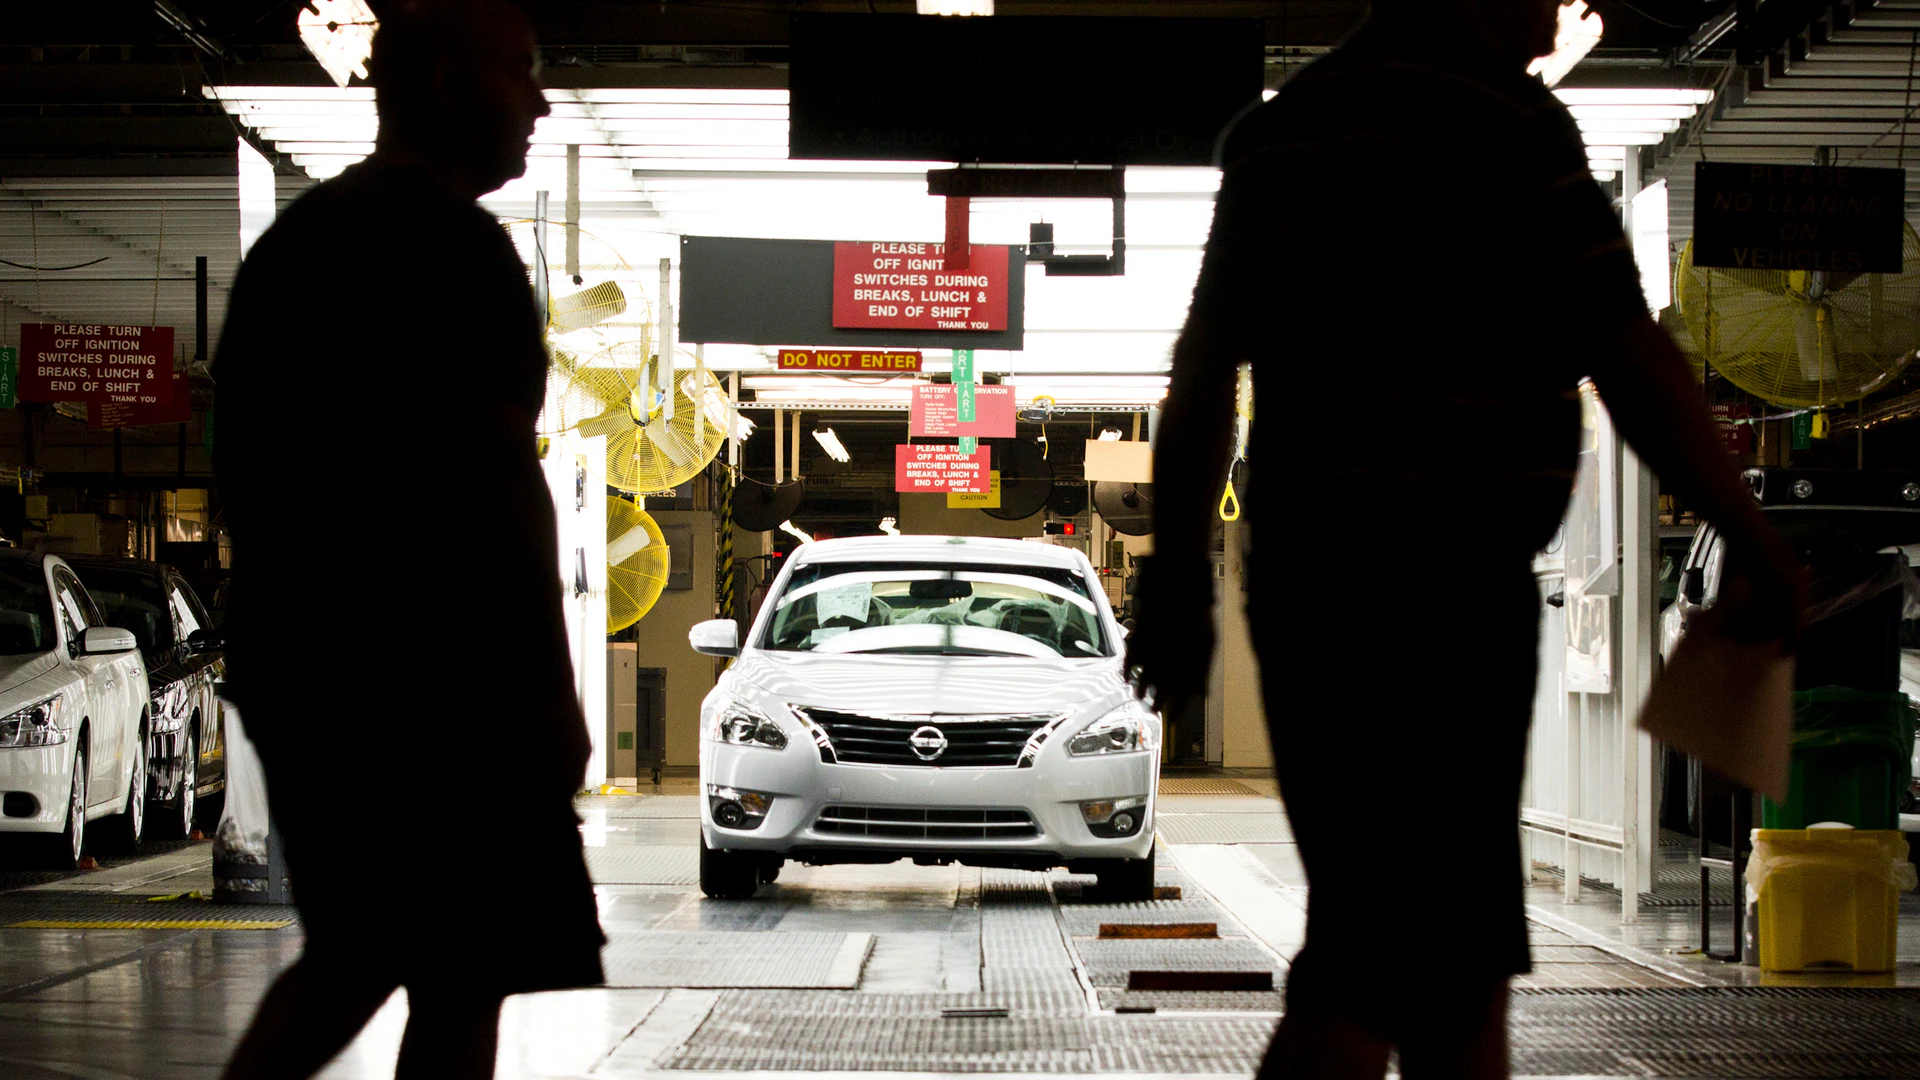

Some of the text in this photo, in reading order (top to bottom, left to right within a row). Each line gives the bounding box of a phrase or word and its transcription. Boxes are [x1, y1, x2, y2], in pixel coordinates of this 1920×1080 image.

[872, 243, 926, 254] PLEASE
[874, 259, 945, 270] OFF IGNIT
[854, 274, 988, 287] SWITCHES DURING
[854, 290, 987, 303] BREAKS, LUNCH &
[869, 305, 971, 318] END OF SHIFT
[54, 325, 141, 336] PLEASE TURN
[937, 321, 989, 329] THANK YOU
[55, 339, 140, 350] OFF IGNITION
[38, 353, 156, 365] SWITCHES DURING
[783, 353, 916, 369] DO NOT ENTER
[38, 367, 155, 379] BREAKS, LUNCH &
[51, 381, 141, 393] END OF SHIFT
[919, 386, 951, 394] BATTERY
[962, 382, 970, 418] ART
[906, 471, 940, 479] BREAKS,
[973, 471, 979, 479] &
